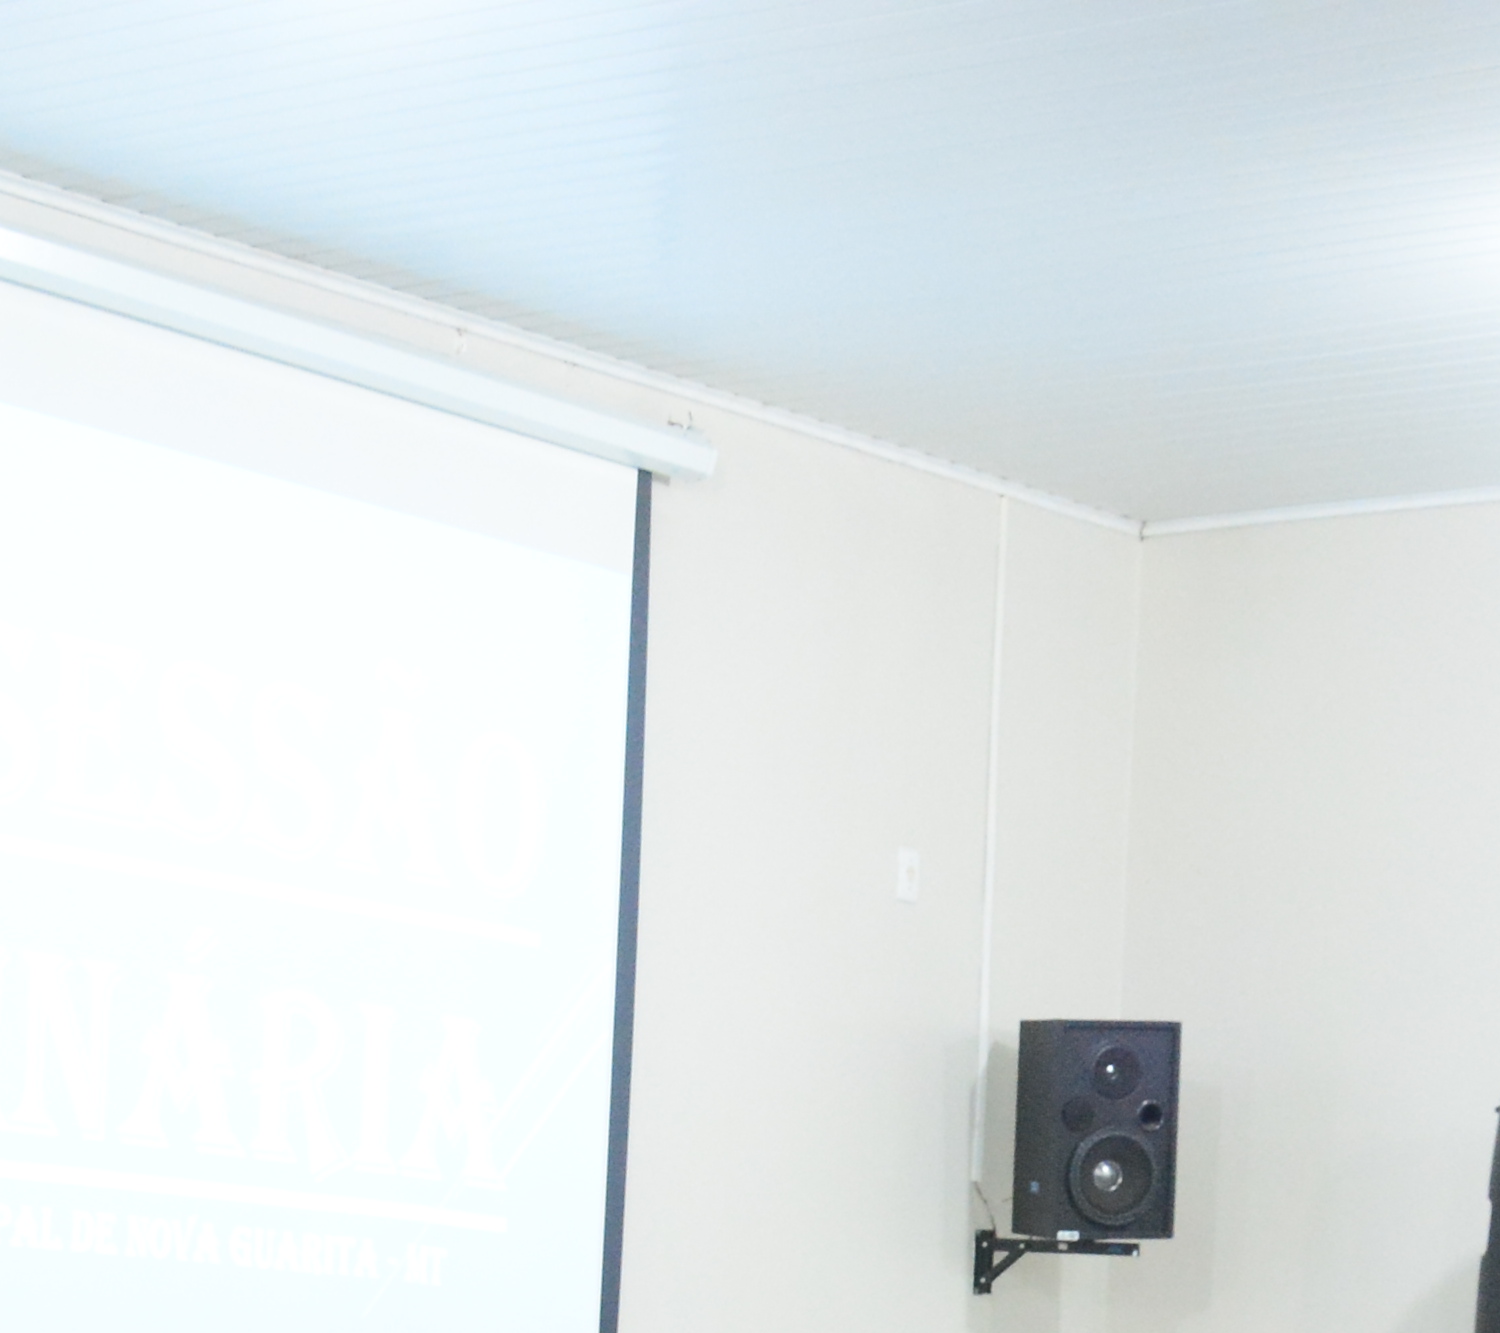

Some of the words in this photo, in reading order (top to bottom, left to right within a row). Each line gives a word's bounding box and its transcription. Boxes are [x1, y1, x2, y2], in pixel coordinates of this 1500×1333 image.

[71, 1209, 117, 1255] DE
[125, 1214, 220, 1264] NOVA
[231, 1227, 378, 1277] GUARITA
[405, 1245, 447, 1286] MT
